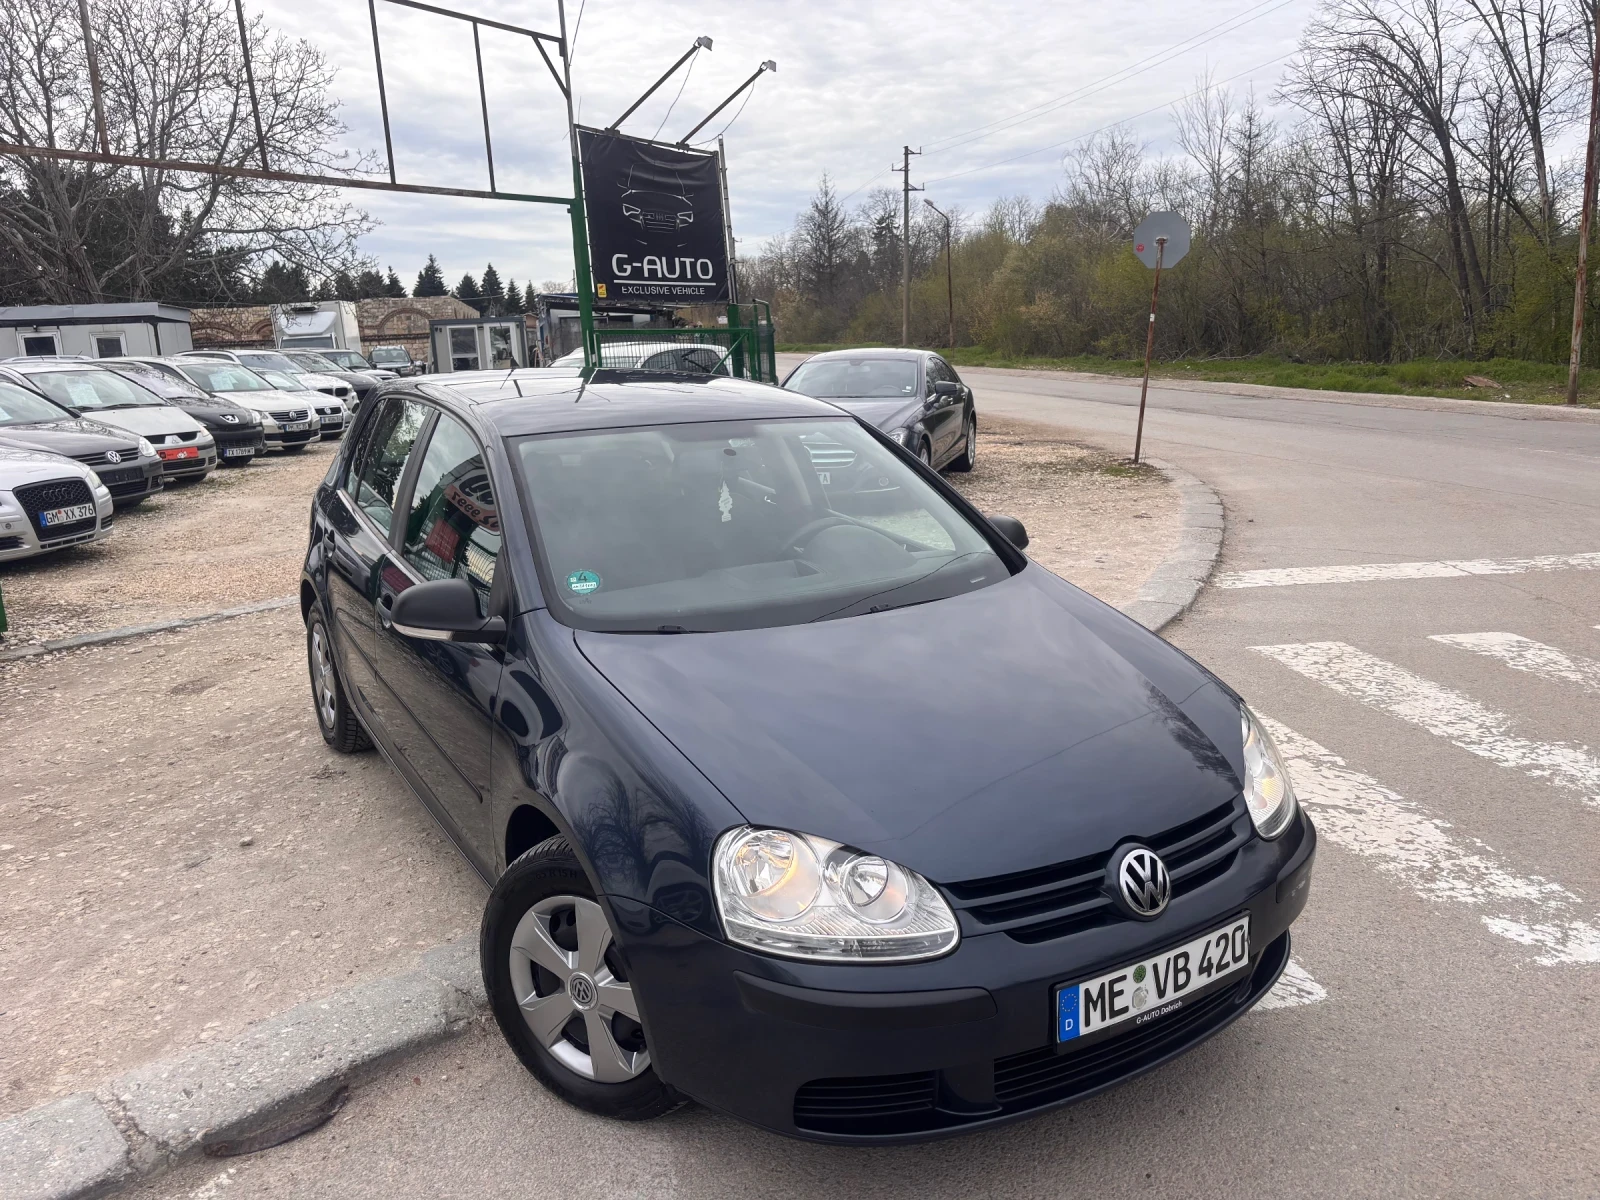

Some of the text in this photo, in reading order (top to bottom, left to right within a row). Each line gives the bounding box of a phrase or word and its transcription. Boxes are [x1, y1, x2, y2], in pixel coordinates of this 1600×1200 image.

[611, 253, 714, 279] G-AUTO
[621, 286, 706, 295] EXCLUSIVE VEHICLE
[45, 511, 60, 524] GM
[63, 507, 77, 520] XX
[77, 504, 94, 517] 376
[577, 571, 588, 582] 4
[1064, 923, 1246, 1031] D ME VB 420
[1136, 1000, 1183, 1024] G-AUTO Dobrich
